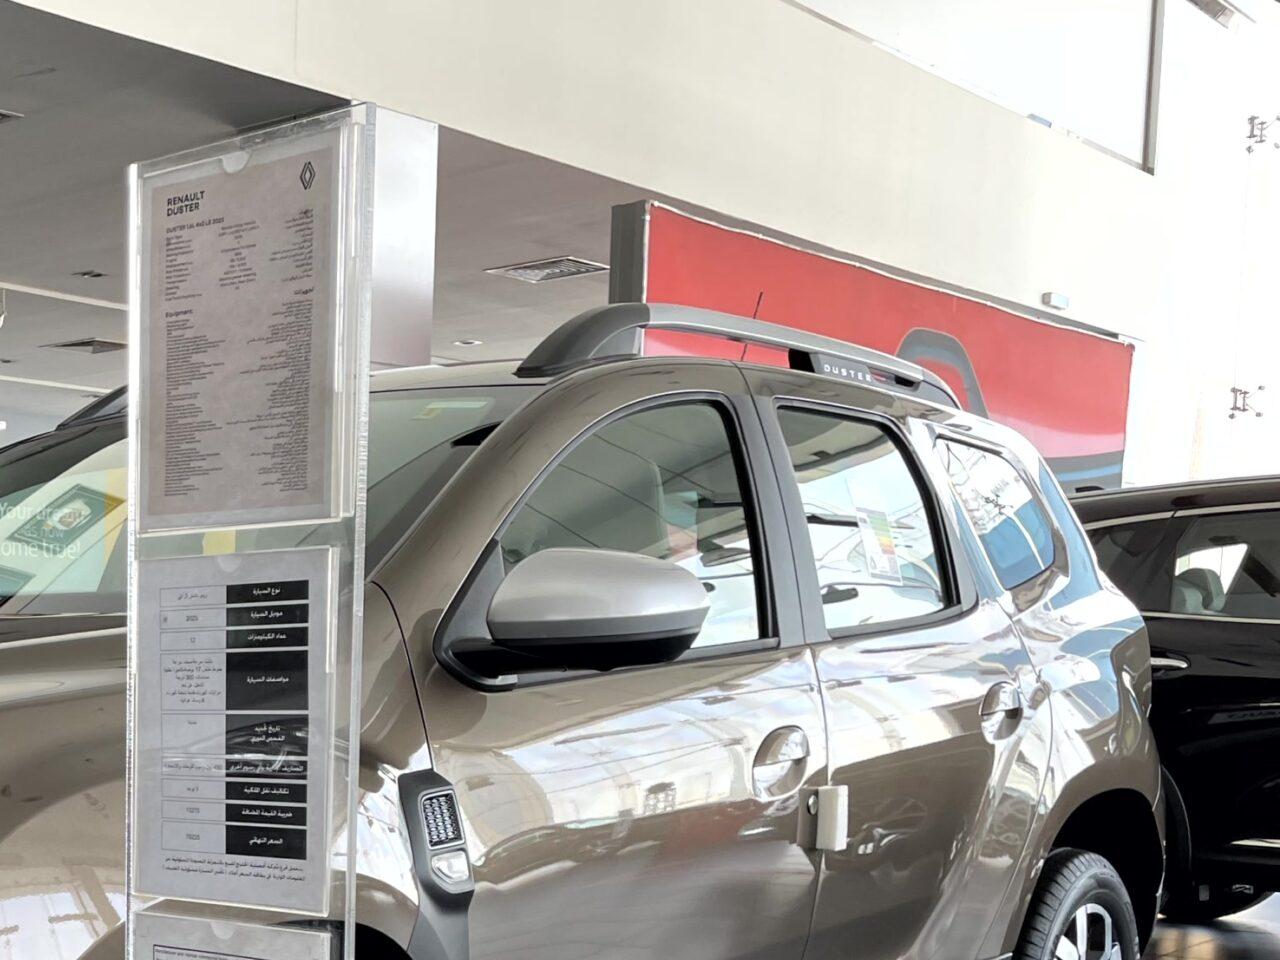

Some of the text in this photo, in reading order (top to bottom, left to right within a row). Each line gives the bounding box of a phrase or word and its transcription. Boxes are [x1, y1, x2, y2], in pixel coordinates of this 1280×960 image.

[167, 191, 205, 207] RENAULT
[166, 202, 200, 217] DUSTER
[824, 364, 872, 382] DUSTER
[43, 540, 81, 560] true!
[252, 587, 281, 596] نوع السيارة
[250, 610, 268, 618] السيارة
[247, 675, 266, 684] السيارة
